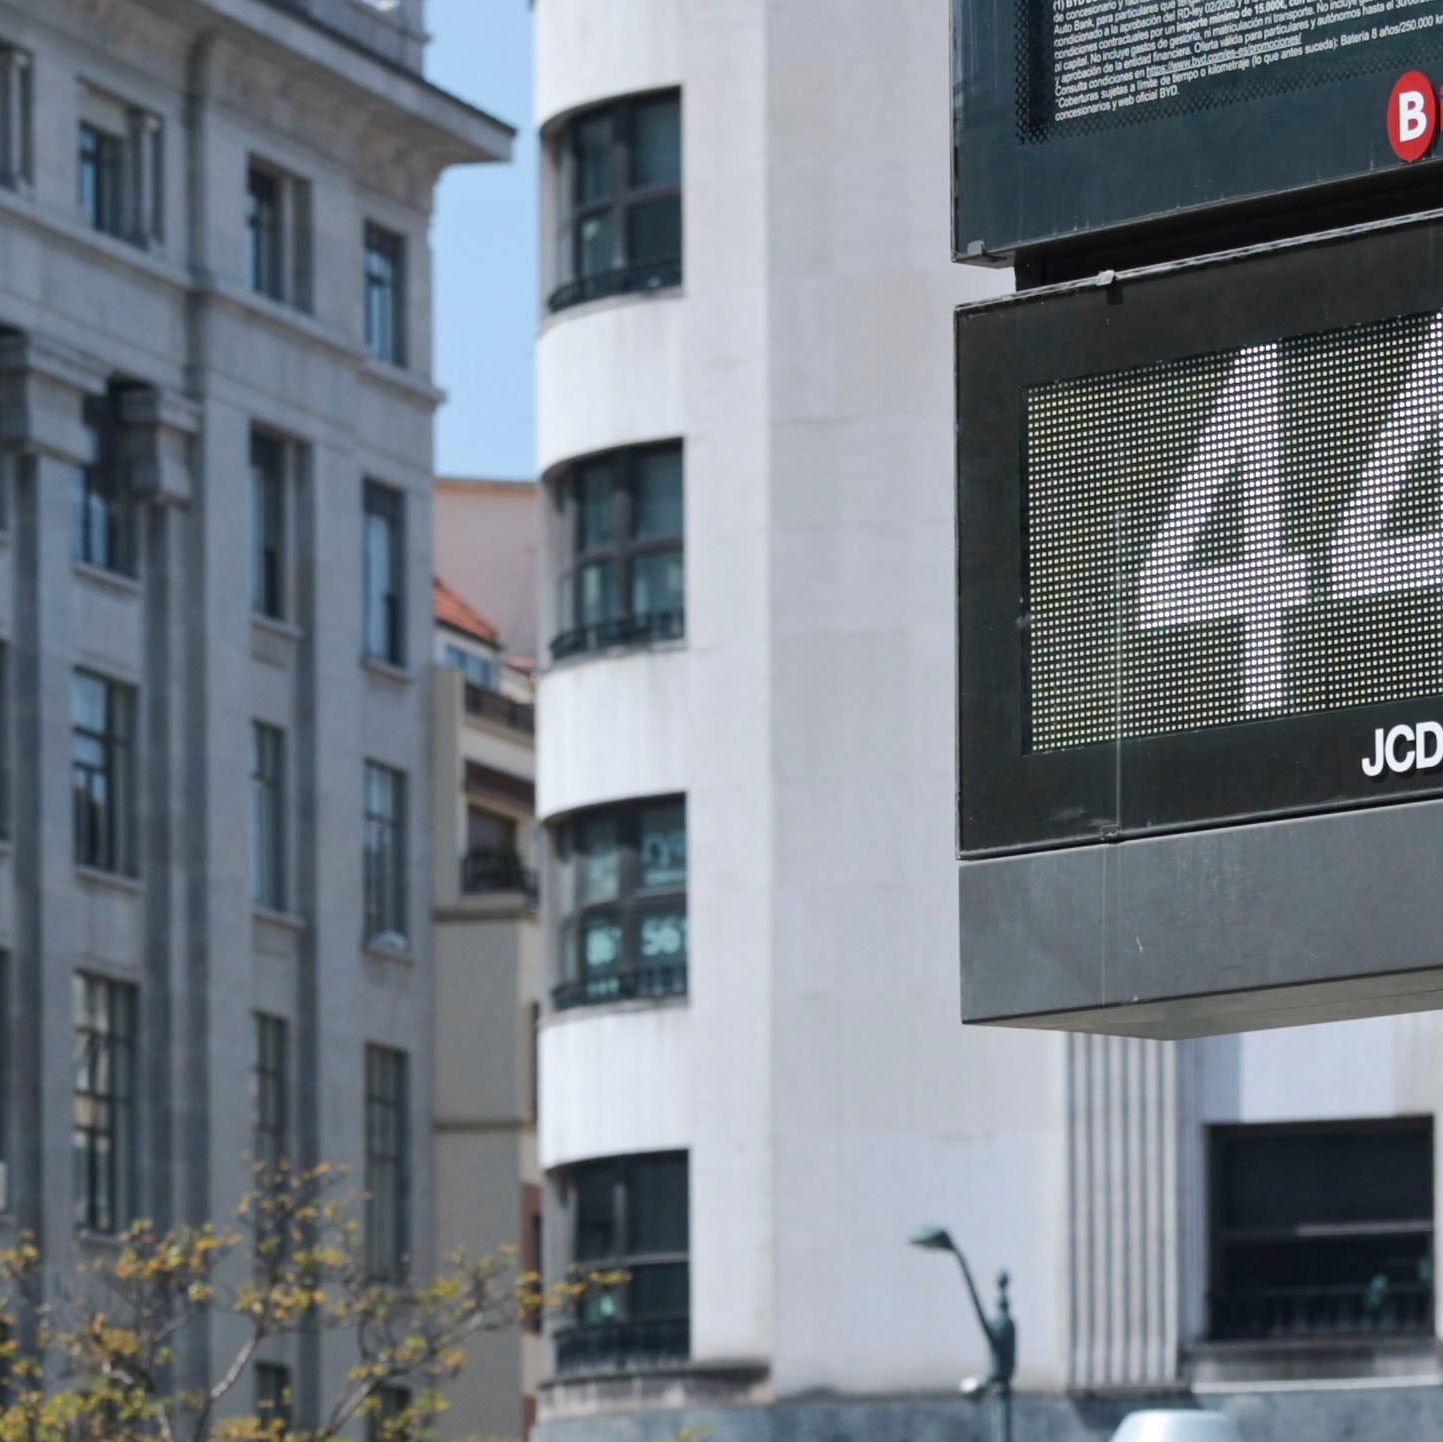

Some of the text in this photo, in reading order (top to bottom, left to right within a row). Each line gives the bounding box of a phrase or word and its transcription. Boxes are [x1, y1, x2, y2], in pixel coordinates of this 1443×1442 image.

[1054, 12, 1064, 22] de
[1066, 0, 1116, 20] concesionario
[1054, 22, 1072, 35] Auto
[1096, 14, 1113, 27] para
[1115, 4, 1159, 23] particulares
[1160, 0, 1175, 13] que
[1054, 27, 1102, 47] condicionado
[1104, 27, 1109, 35] a
[1111, 24, 1118, 34] la
[1120, 14, 1161, 33] aprobación
[1163, 10, 1175, 22] del
[1054, 42, 1097, 59] condiciones
[1099, 30, 1149, 49] contractuales
[1150, 28, 1162, 40] por
[1165, 25, 1175, 34] un
[1177, 16, 1207, 32] importe
[1242, 7, 1252, 17] de
[1054, 61, 1061, 72] al
[1091, 53, 1101, 64] No
[1103, 48, 1130, 61] incluye
[1131, 42, 1156, 57] gastos
[1158, 38, 1168, 49] de
[1204, 27, 1211, 38] ni
[1213, 16, 1263, 36] matriculación
[1265, 14, 1272, 25] ni
[1317, 0, 1328, 13] No
[1055, 76, 1060, 86] y
[1062, 65, 1101, 84] aprobación
[1103, 63, 1113, 73] de
[1115, 60, 1122, 70] la
[1124, 53, 1151, 68] entidad
[1194, 39, 1218, 53] Oferta
[1245, 30, 1262, 44] para
[1264, 20, 1309, 39] particulares
[1311, 18, 1316, 29] y
[1318, 8, 1361, 25] autónomos
[1363, 1, 1384, 15] hasta
[1387, 0, 1393, 10] el
[1101, 85, 1128, 99] sujetas
[1130, 84, 1135, 92] a
[1160, 75, 1171, 85] de
[1172, 70, 1198, 83] tiempo
[1200, 68, 1206, 76] o
[1208, 58, 1250, 75] kilometraje
[1252, 54, 1262, 67] (lo
[1264, 52, 1279, 65] que
[1281, 46, 1303, 59] antes
[1372, 28, 1377, 39] 8
[1055, 81, 1087, 97] Consulta
[1089, 72, 1133, 89] condiciones
[1135, 69, 1145, 78] en
[1055, 101, 1110, 121] concesionarios
[1112, 100, 1117, 111] y
[1118, 94, 1134, 107] web
[1136, 89, 1157, 103] oficial
